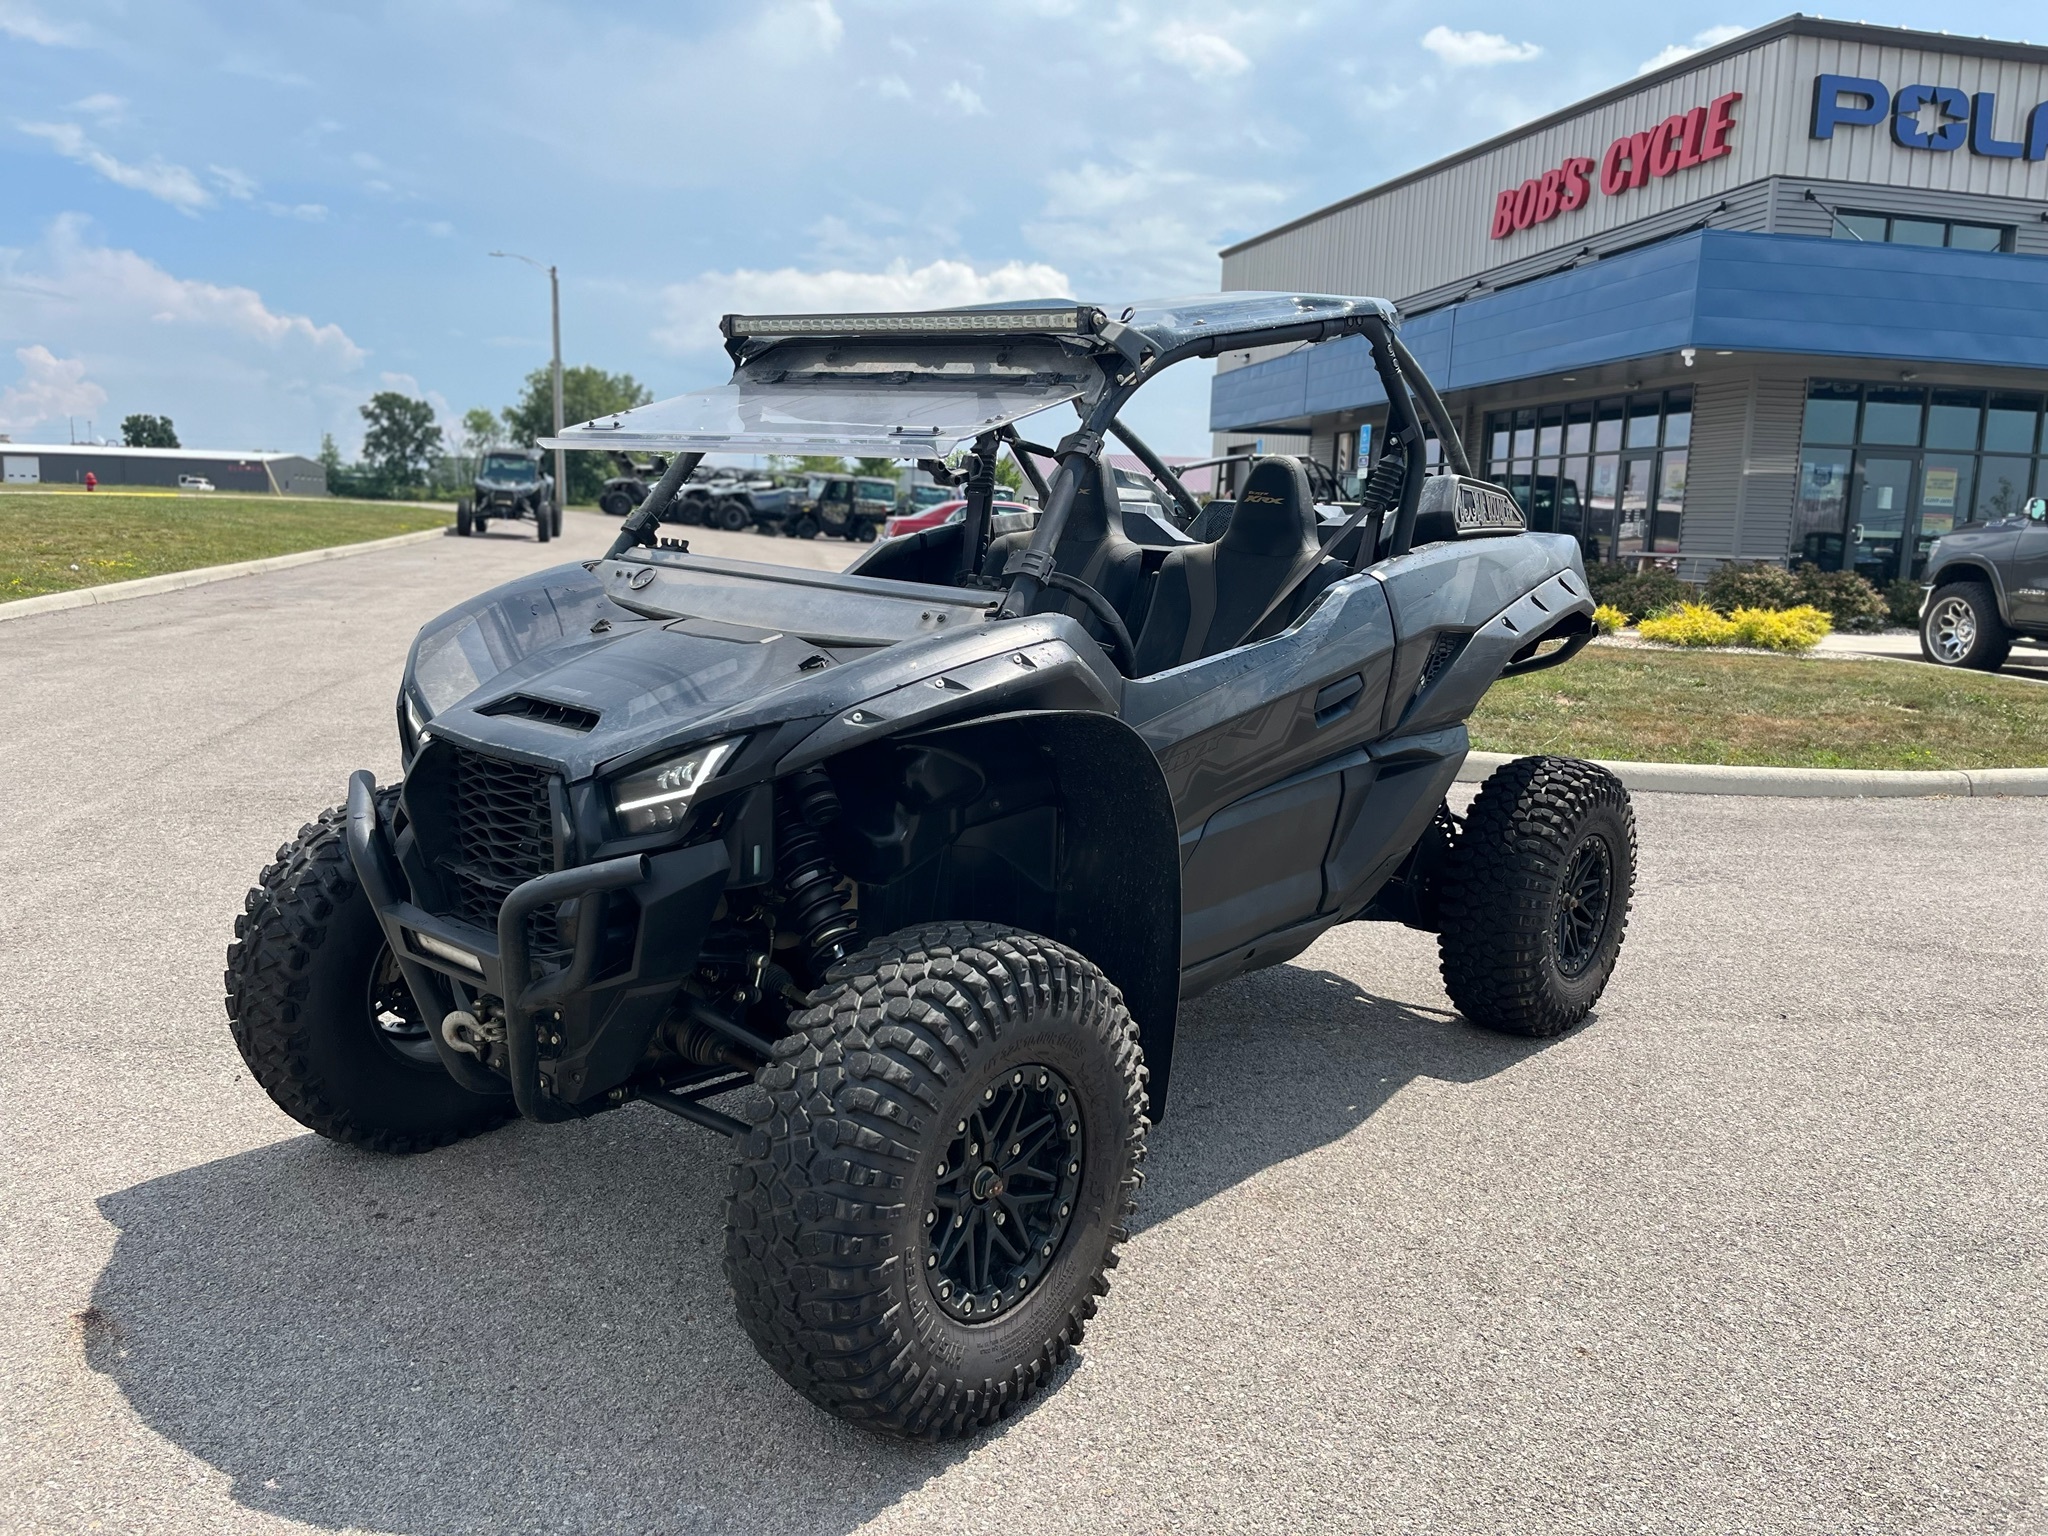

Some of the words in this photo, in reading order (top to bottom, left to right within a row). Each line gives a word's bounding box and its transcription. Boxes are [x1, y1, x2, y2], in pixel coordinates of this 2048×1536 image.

[1491, 157, 1595, 240] BOB'S
[1601, 92, 1743, 196] CYCLE
[2019, 588, 2046, 596] RAM
